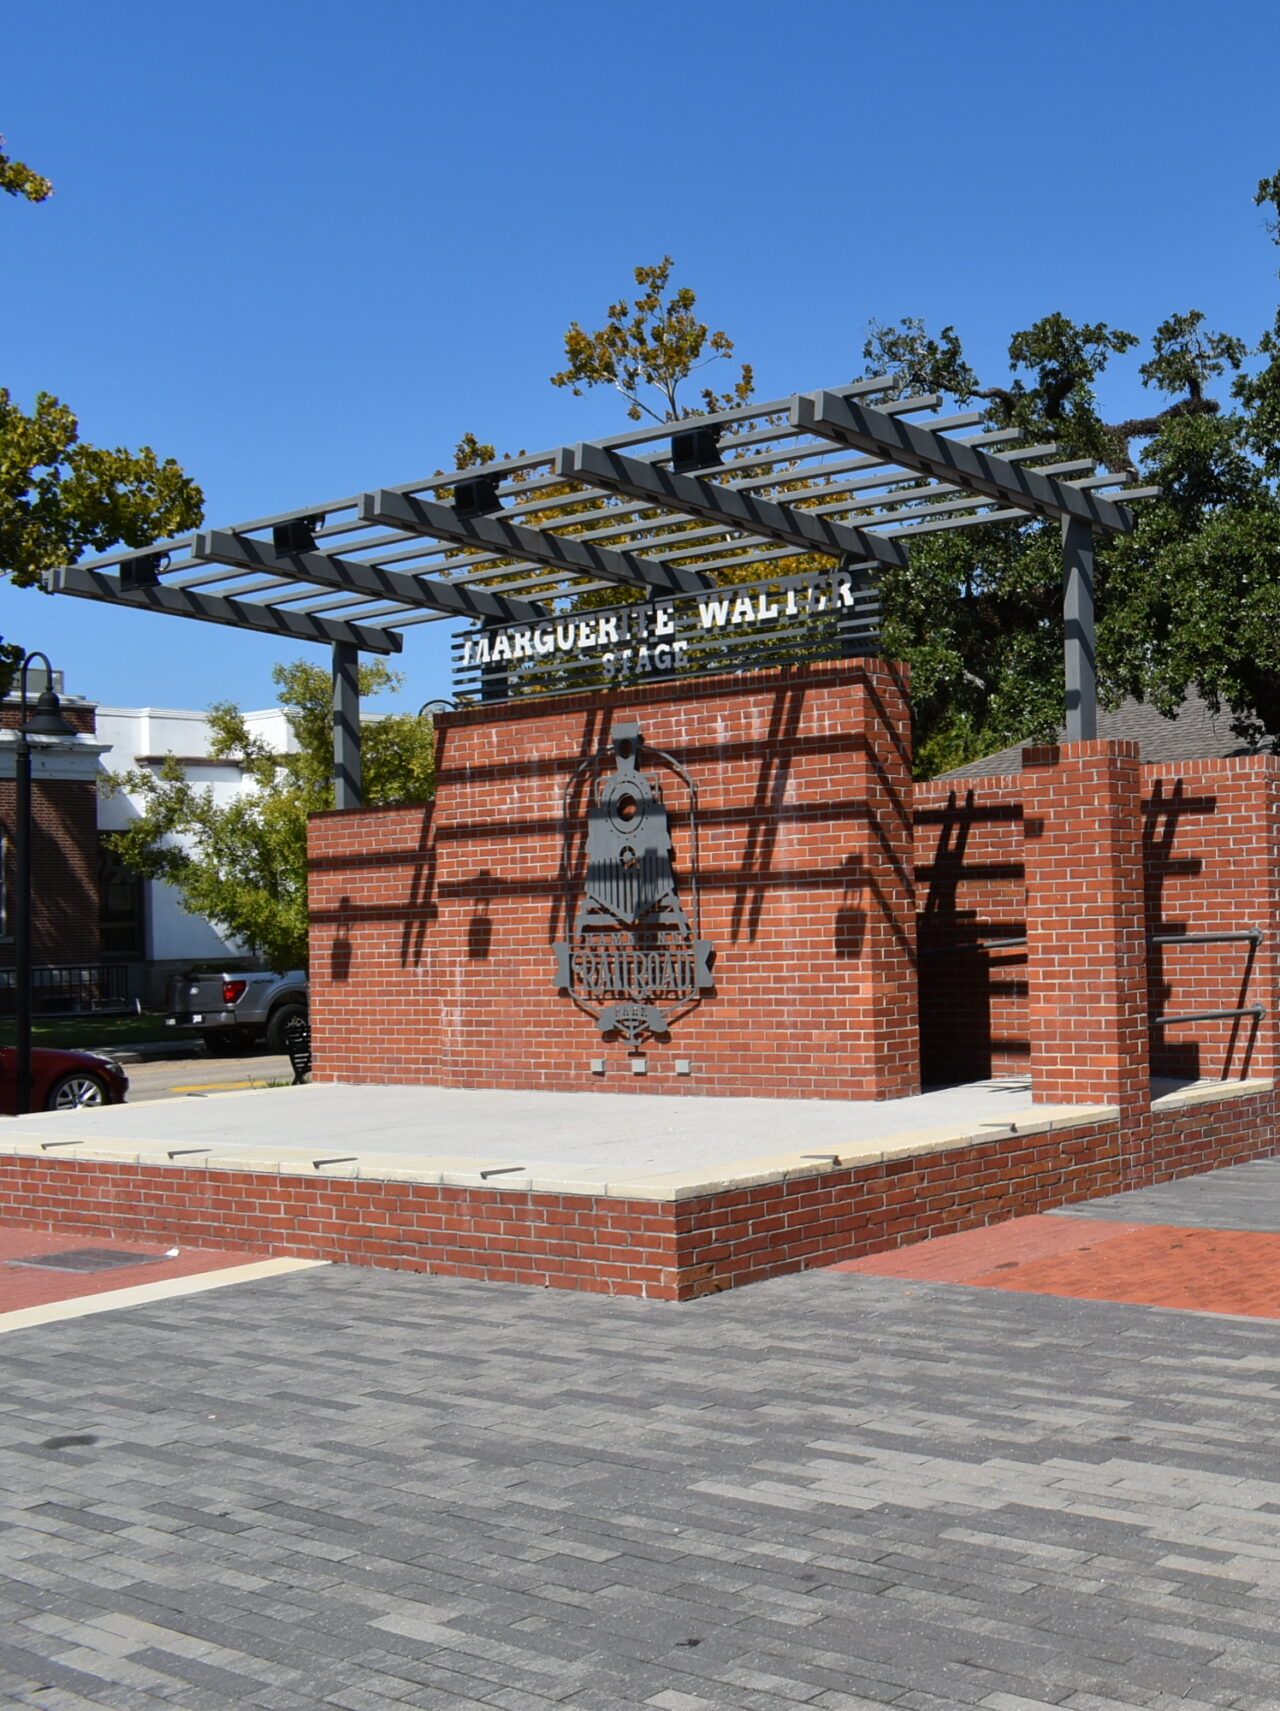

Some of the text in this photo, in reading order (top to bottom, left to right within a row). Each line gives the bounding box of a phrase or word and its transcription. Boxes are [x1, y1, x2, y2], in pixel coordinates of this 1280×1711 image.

[463, 573, 854, 665] MARGUERITE WALTER
[603, 641, 688, 678] STAGE
[572, 950, 692, 999] RAILROAD
